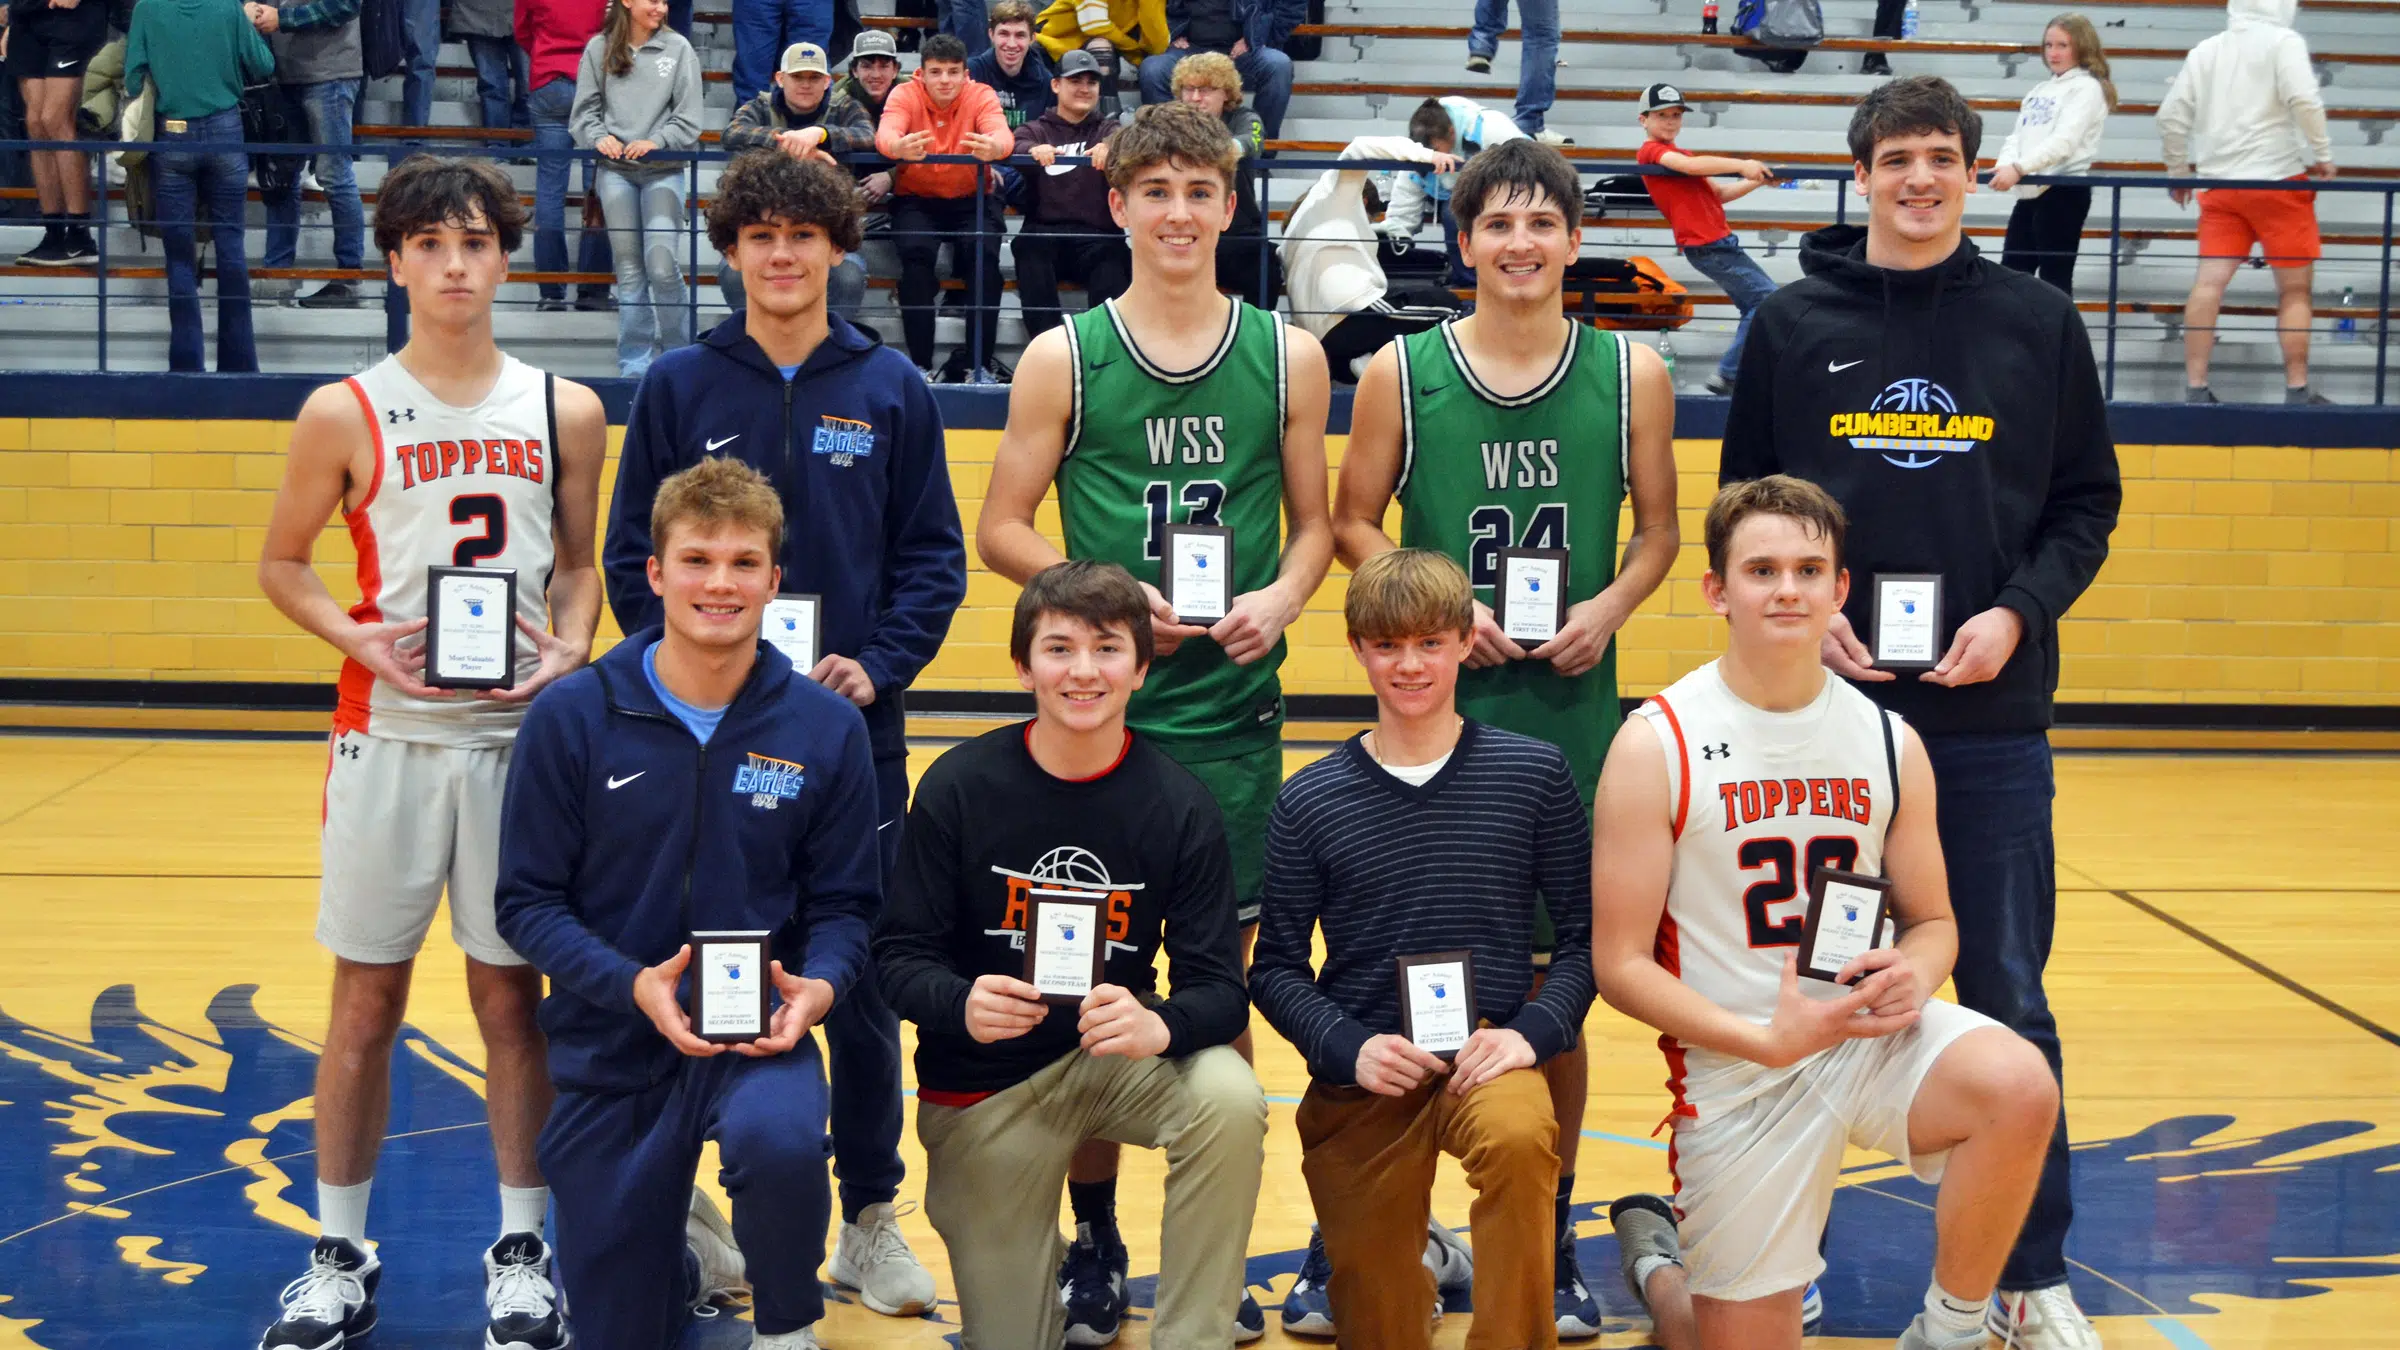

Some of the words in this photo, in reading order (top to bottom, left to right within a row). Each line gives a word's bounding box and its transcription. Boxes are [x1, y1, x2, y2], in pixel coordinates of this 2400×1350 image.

[812, 426, 874, 457] EAGLES
[1144, 415, 1225, 465] WSS
[1830, 413, 1995, 441] CUMBERLAND
[396, 439, 544, 490] TOPPERS
[1480, 439, 1559, 489] WSS
[449, 493, 509, 567] 2
[1468, 503, 1570, 589] 24
[732, 764, 805, 800] EAGLES
[1719, 778, 1871, 832] TOPPERS
